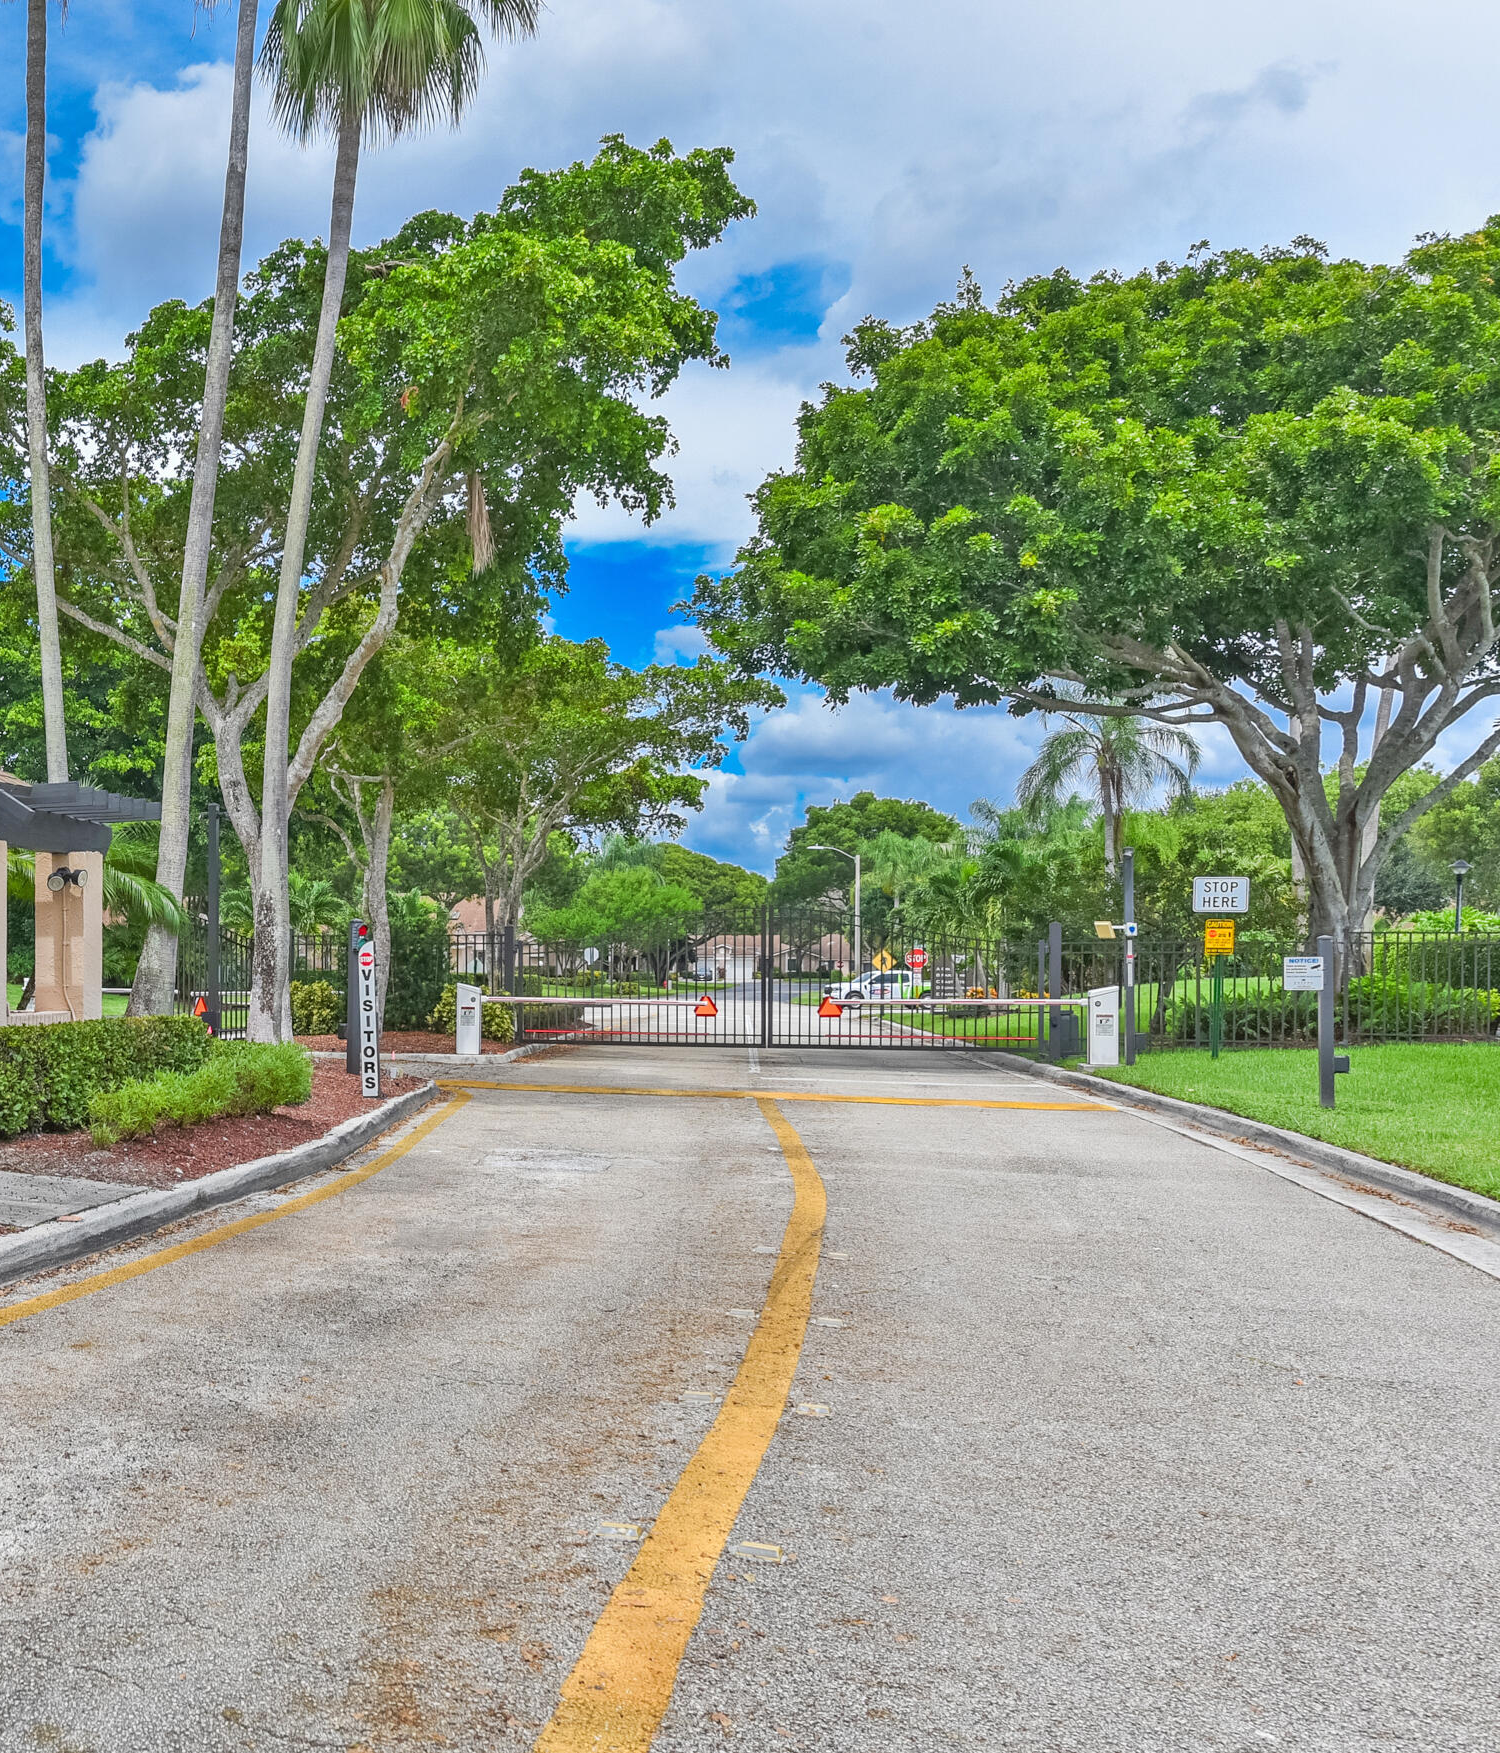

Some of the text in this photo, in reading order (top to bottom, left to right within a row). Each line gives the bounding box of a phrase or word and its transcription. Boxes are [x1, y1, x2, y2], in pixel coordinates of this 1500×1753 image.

[1203, 881, 1239, 893] STOP
[1202, 896, 1239, 908] HERE
[906, 954, 927, 963] STOP
[361, 969, 376, 1090] VISITORS
